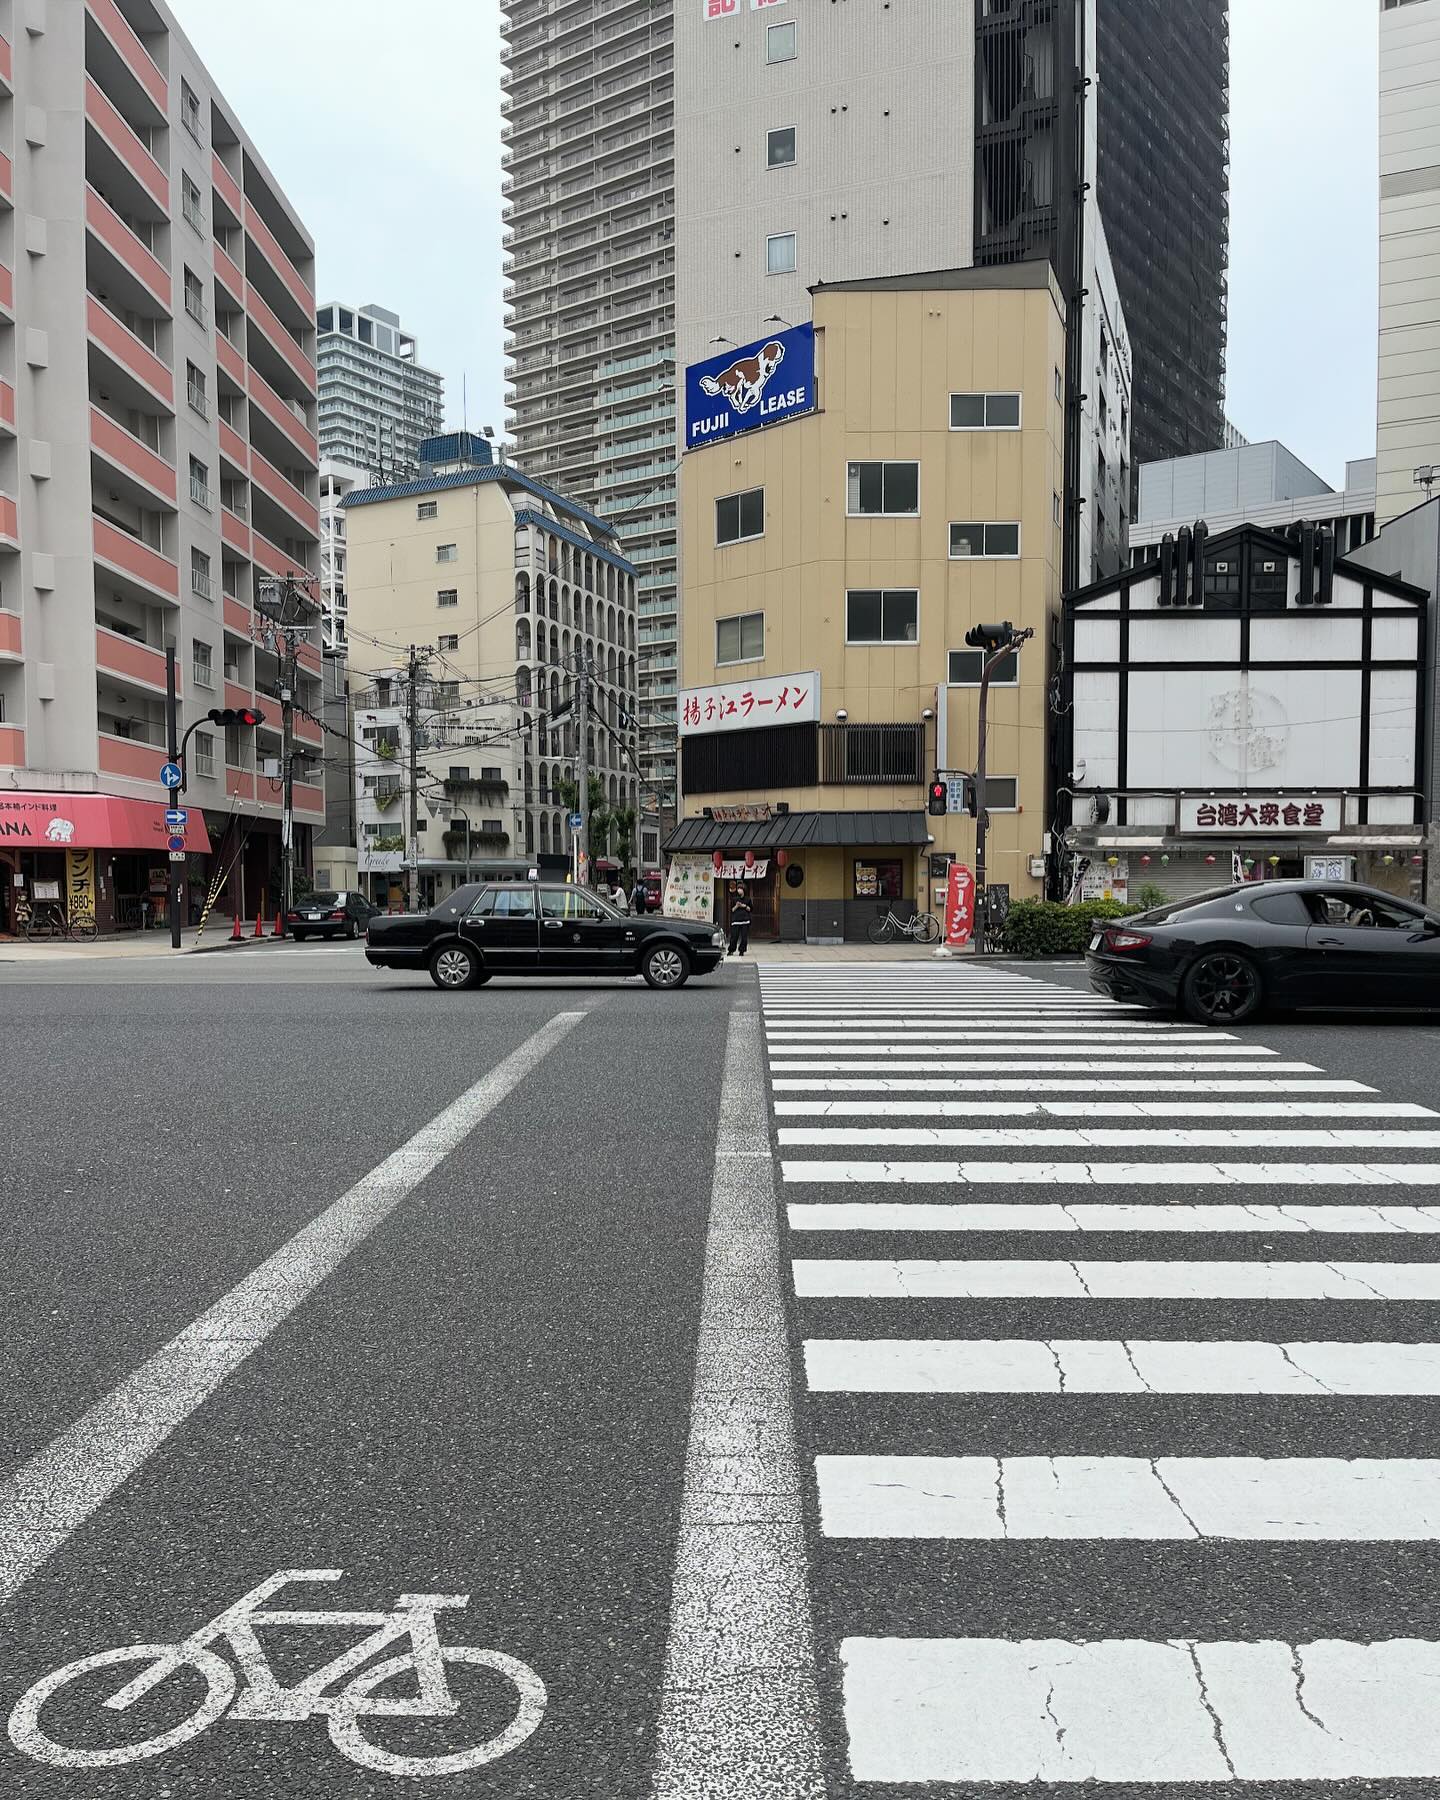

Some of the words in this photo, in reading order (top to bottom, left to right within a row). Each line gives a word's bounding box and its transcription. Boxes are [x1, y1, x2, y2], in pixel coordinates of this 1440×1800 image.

[759, 387, 806, 416] LEASE
[692, 412, 729, 437] FUJII
[683, 687, 809, 726] 揚子江ラーメン
[1196, 802, 1325, 826] 台湾大衆食堂
[72, 849, 91, 893] ランチ
[950, 872, 971, 938] ラーメン
